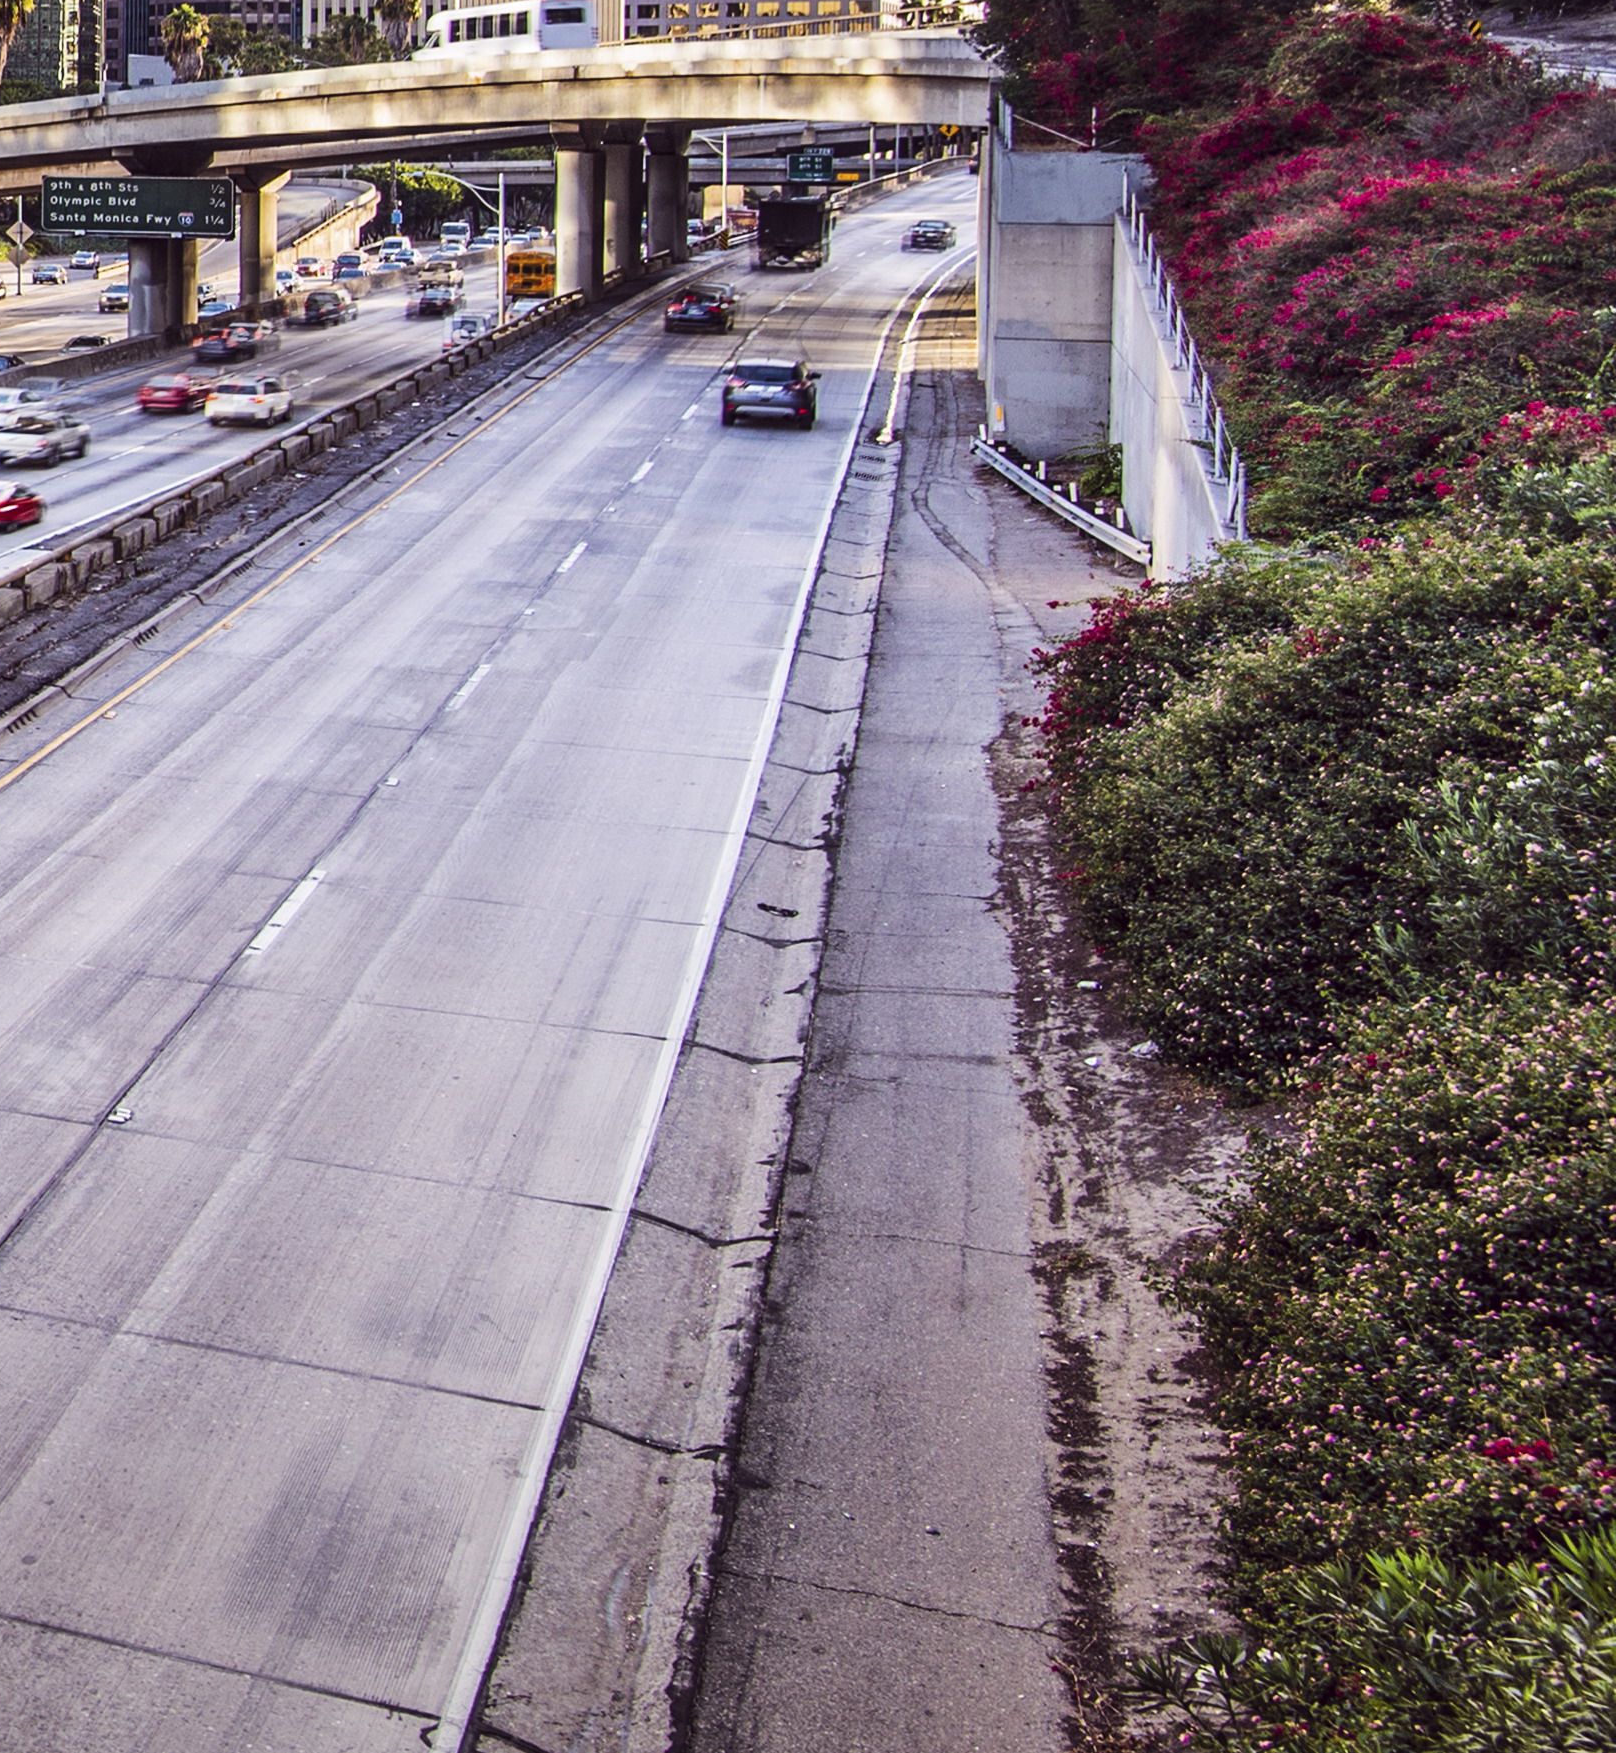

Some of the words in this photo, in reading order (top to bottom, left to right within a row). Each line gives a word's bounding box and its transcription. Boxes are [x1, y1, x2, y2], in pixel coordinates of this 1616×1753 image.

[50, 181, 72, 191] 9th
[90, 181, 112, 192] 8th
[118, 183, 139, 192] Sts
[50, 195, 102, 207] Olympic
[108, 196, 137, 206] Blvd
[50, 212, 87, 222] Santa
[93, 213, 139, 223] Monica
[146, 214, 172, 226] Fwy
[180, 216, 192, 224] 10
